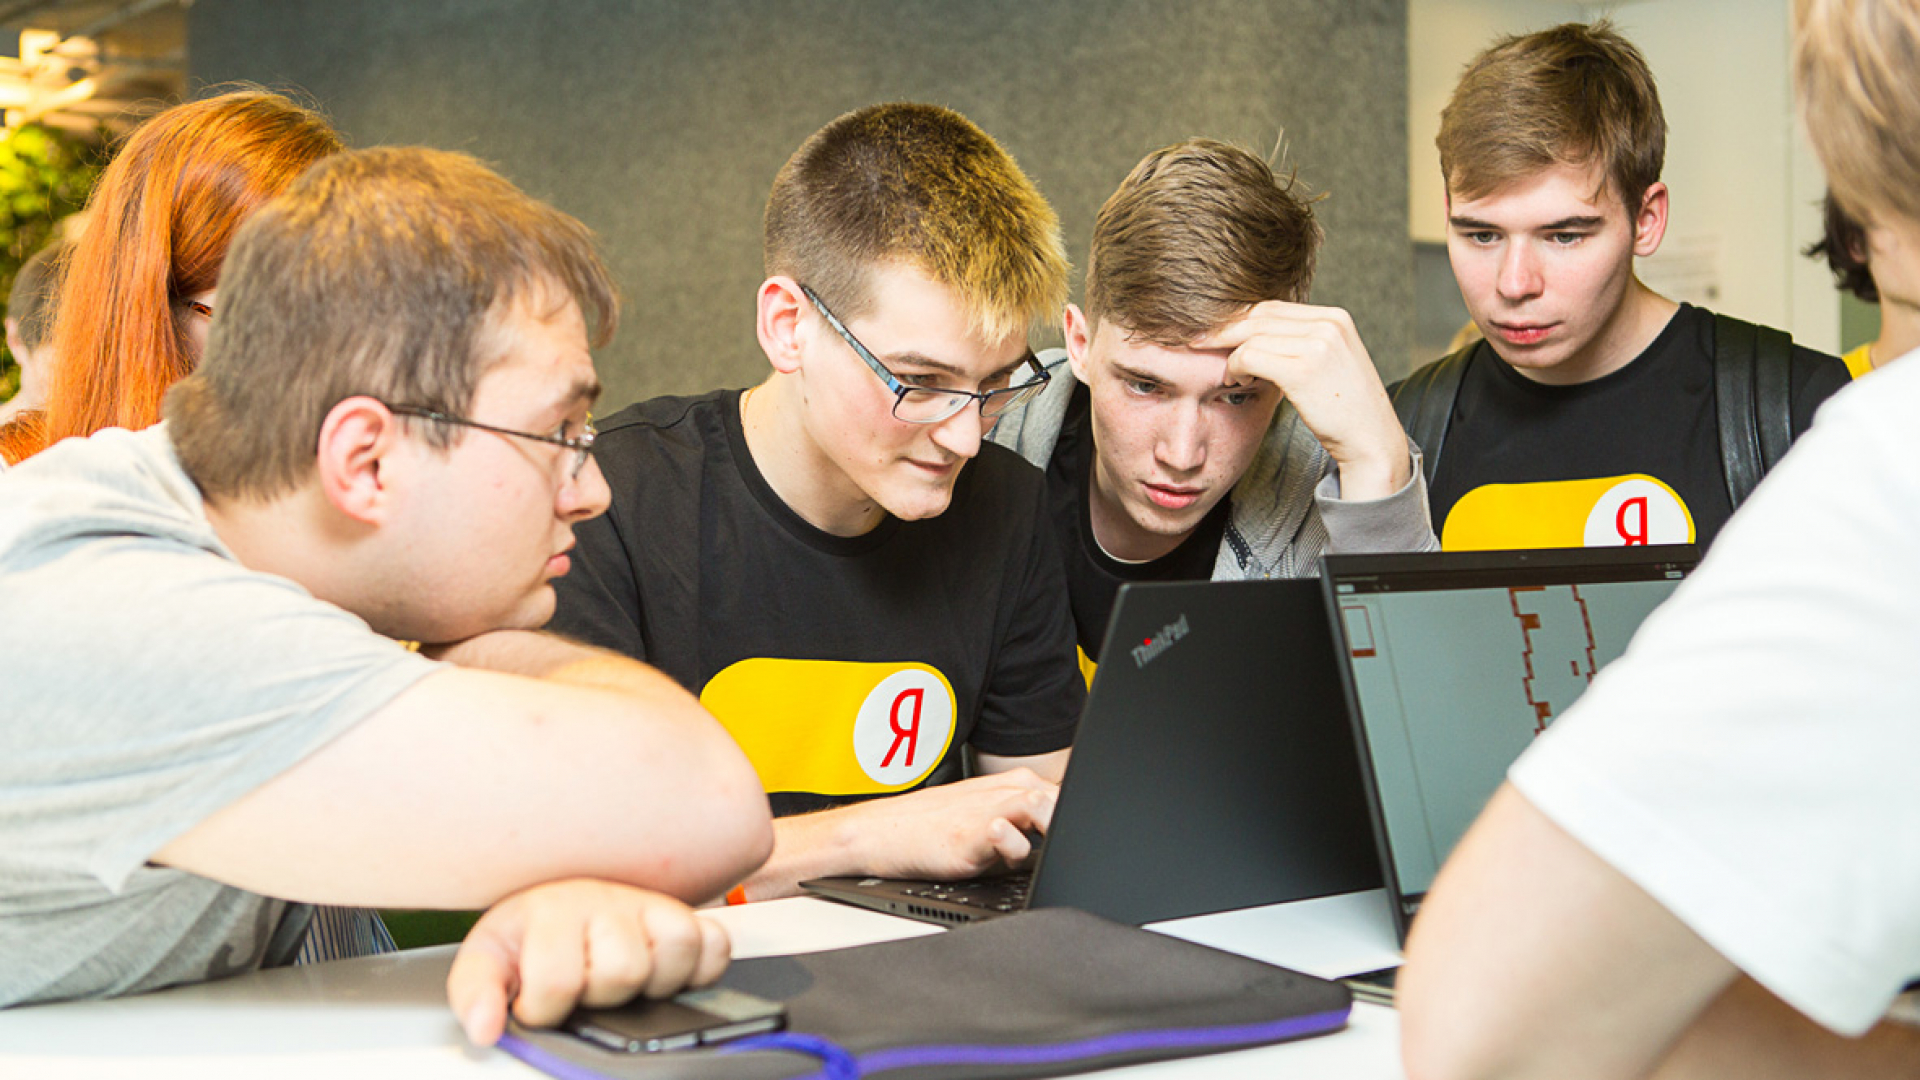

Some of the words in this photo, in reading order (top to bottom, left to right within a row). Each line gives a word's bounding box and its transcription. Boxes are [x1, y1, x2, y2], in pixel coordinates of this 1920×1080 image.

[1616, 497, 1648, 545] Я
[1131, 614, 1189, 668] ThinkPad
[880, 688, 924, 767] Я
